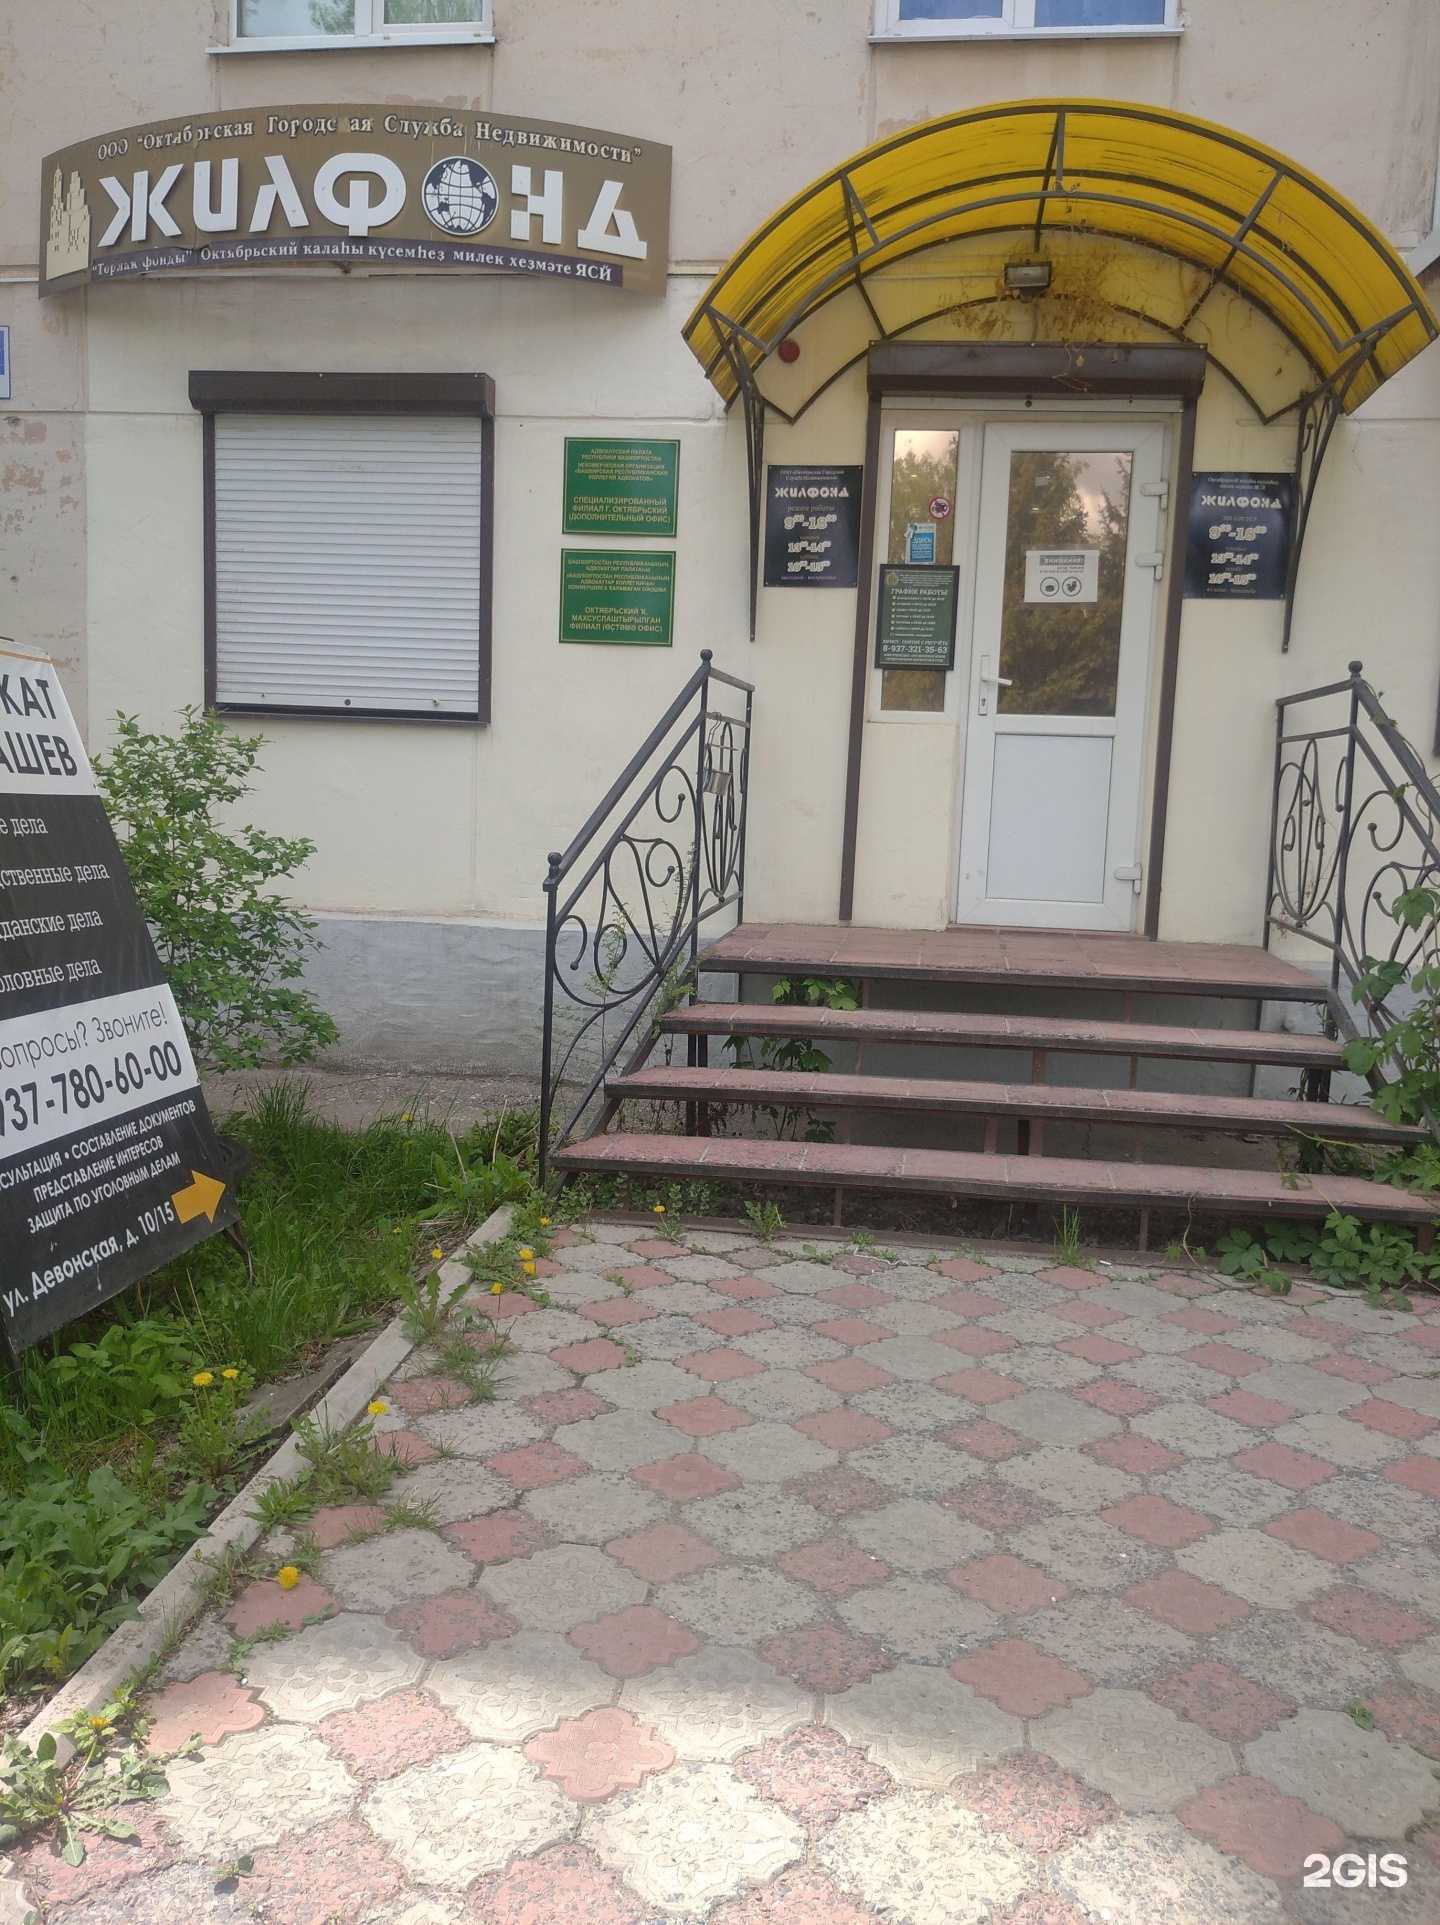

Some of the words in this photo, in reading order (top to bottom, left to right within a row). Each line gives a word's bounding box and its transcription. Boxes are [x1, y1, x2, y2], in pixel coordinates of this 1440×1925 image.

[97, 139, 128, 160] ООО
[267, 115, 373, 138] Городсая
[384, 115, 465, 139] Служба
[200, 241, 297, 261] Октябрьский
[453, 250, 504, 265] милек
[573, 496, 667, 506] СПЕЦИАЛИЗИРОВАННЫЙ
[775, 487, 849, 498] ЖИЛФОНД
[1201, 495, 1282, 509] ЖИЛФОНД
[10, 818, 48, 837] дела
[0, 867, 72, 889] ственные
[74, 864, 110, 883] дела
[0, 915, 65, 941] данские
[67, 911, 103, 932] дела
[65, 959, 102, 983] дела
[0, 1021, 88, 1070] опросы?
[91, 1001, 168, 1043] Звоните!
[0, 1152, 62, 1190] СУЛЬТАЦИЯ
[71, 1124, 138, 1160] СОСТАВЛЕНИЕ
[139, 1100, 196, 1132] ДОКУМЕНТОВ
[33, 1155, 117, 1203] ПРЕДСТАВЛЕНИЕ
[116, 1135, 164, 1166] ИНТЕРЕСОВ
[27, 1201, 74, 1234] ЗАЩИТА
[73, 1193, 91, 1213] ПО
[91, 1167, 150, 1204] УГОЛОВНЫМ
[150, 1152, 181, 1178] ДЕЛАМ
[3, 1287, 29, 1318] ул.
[31, 1236, 123, 1300] Девонская,
[126, 1228, 139, 1248] д.
[138, 1201, 175, 1236] 10/15
